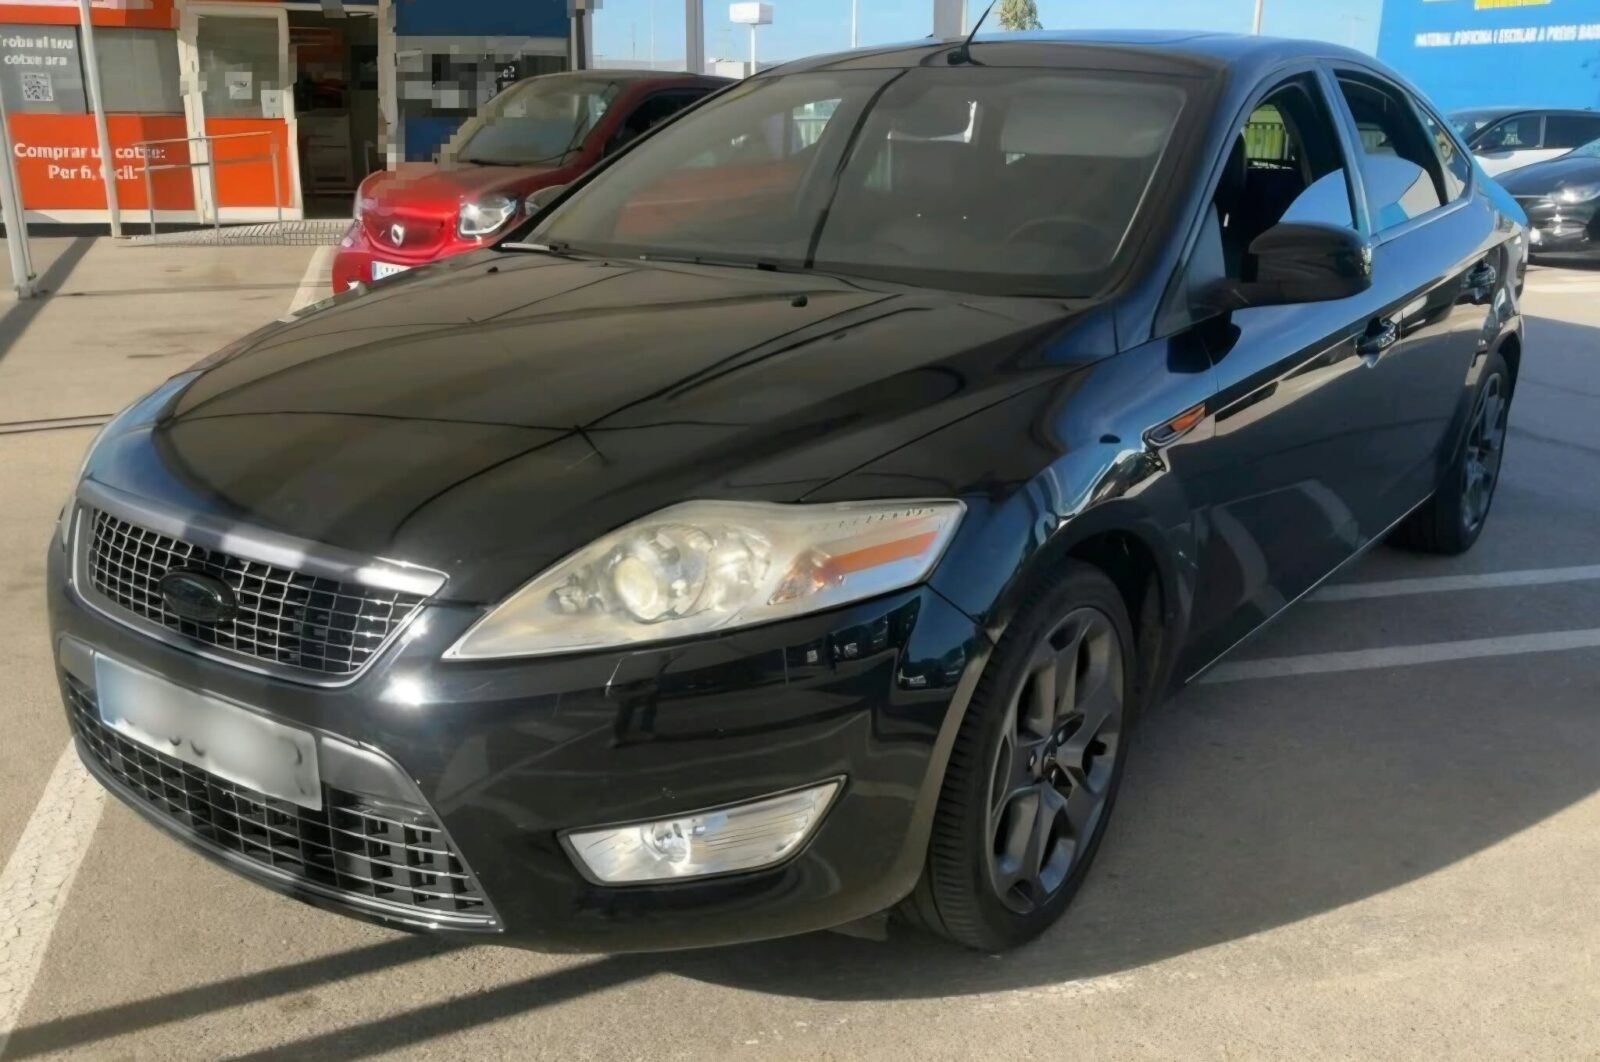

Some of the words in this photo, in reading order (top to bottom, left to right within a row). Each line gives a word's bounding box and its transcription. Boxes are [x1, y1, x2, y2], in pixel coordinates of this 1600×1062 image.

[0, 34, 34, 48] roba
[14, 142, 88, 161] Comprar
[48, 164, 78, 180] Per
